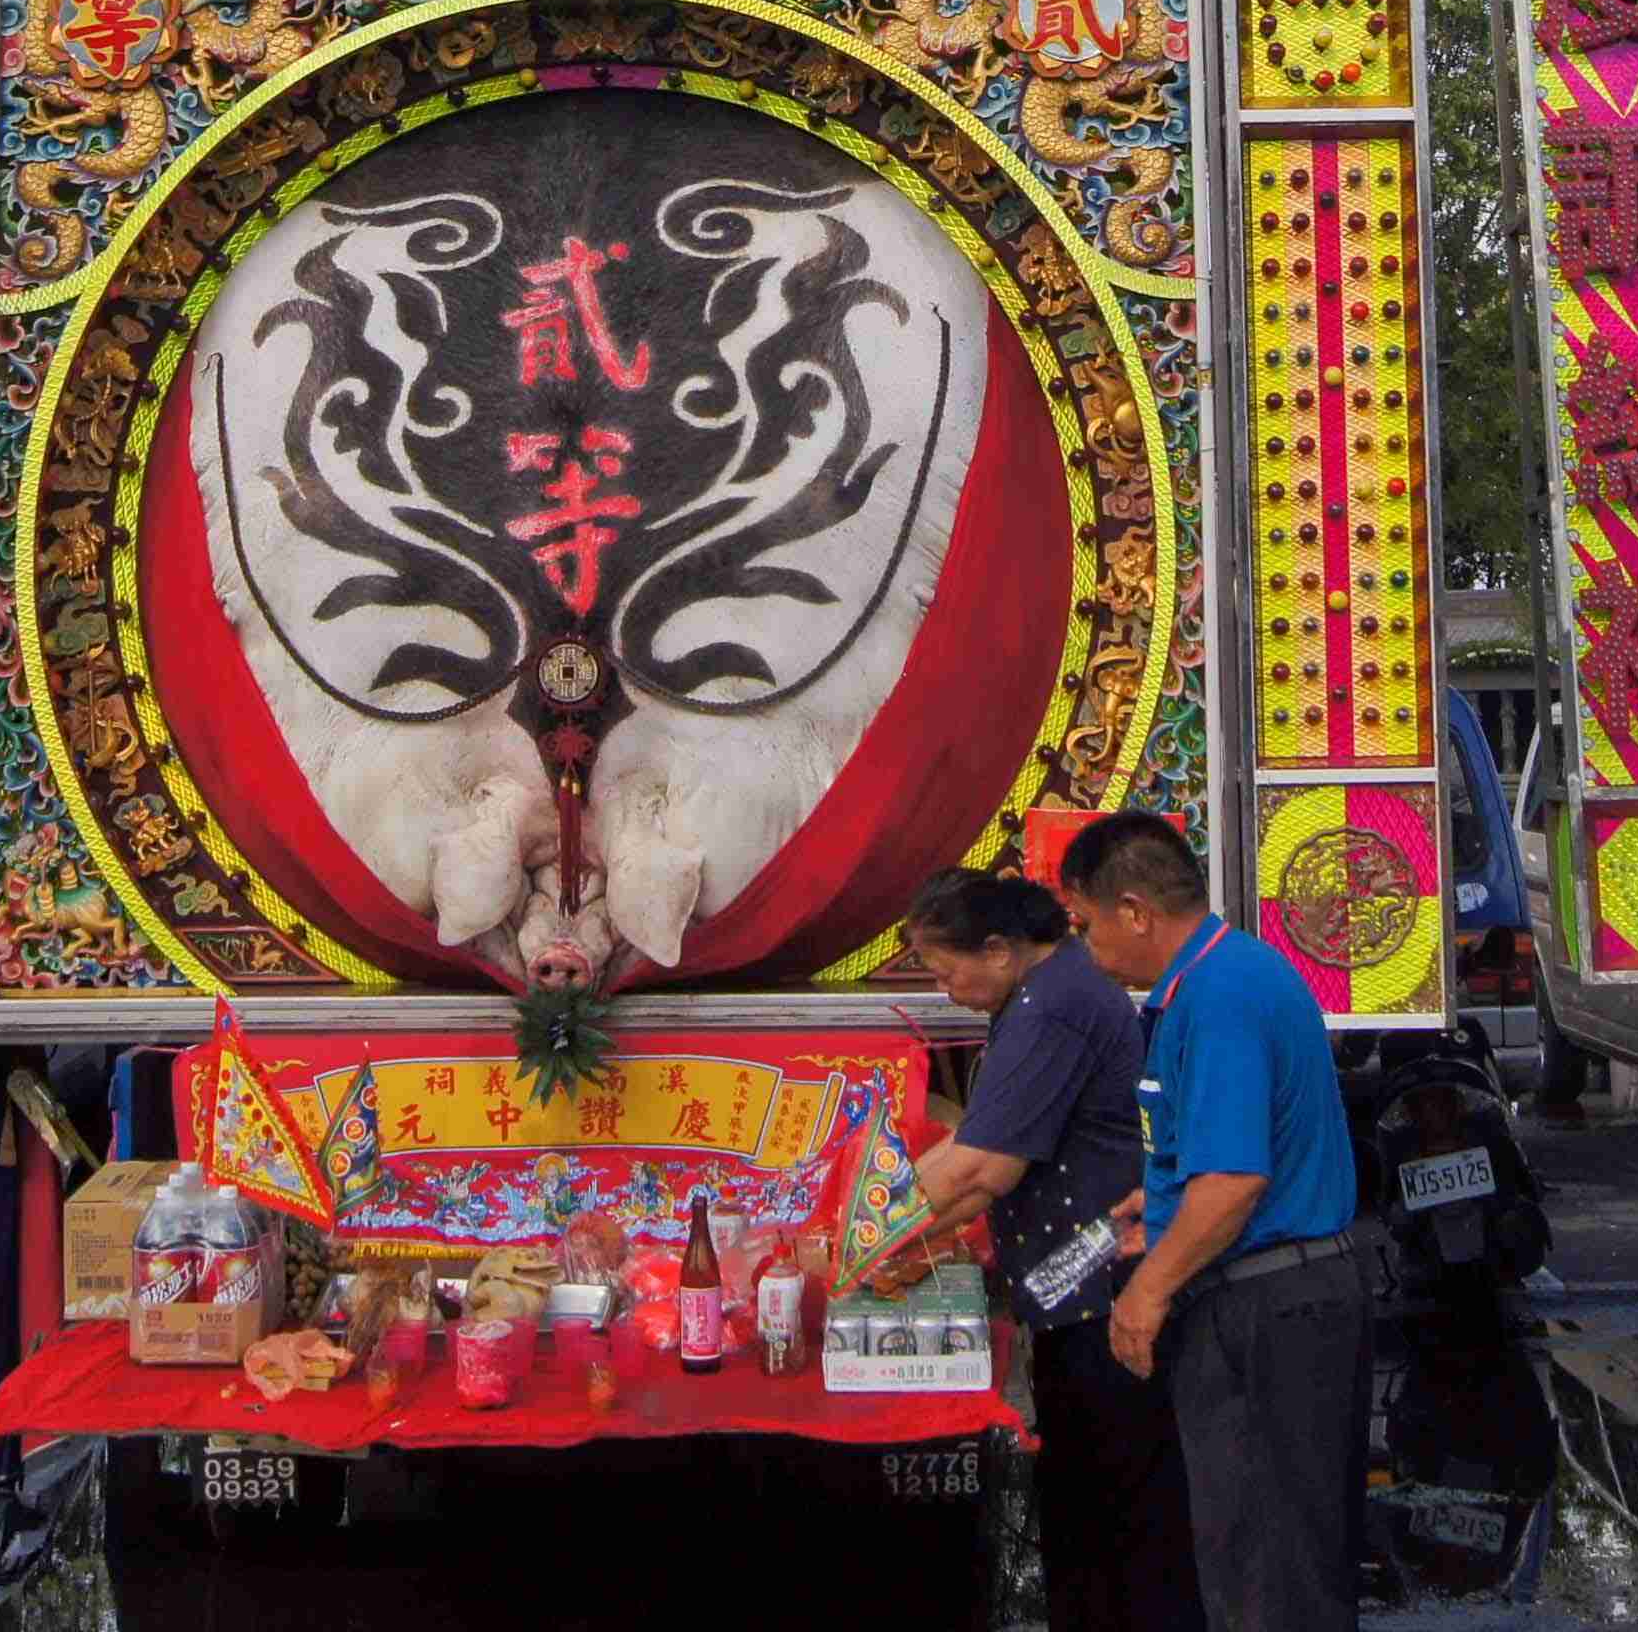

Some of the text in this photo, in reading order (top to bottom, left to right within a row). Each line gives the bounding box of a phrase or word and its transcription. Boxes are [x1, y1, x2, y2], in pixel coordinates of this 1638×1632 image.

[424, 1063, 689, 1097] 溪南義祠
[394, 1097, 716, 1145] 慶讚中元
[204, 1457, 295, 1480] 03-59
[881, 1452, 979, 1474] 97776
[204, 1479, 295, 1500] 09321
[889, 1473, 980, 1496] 12188
